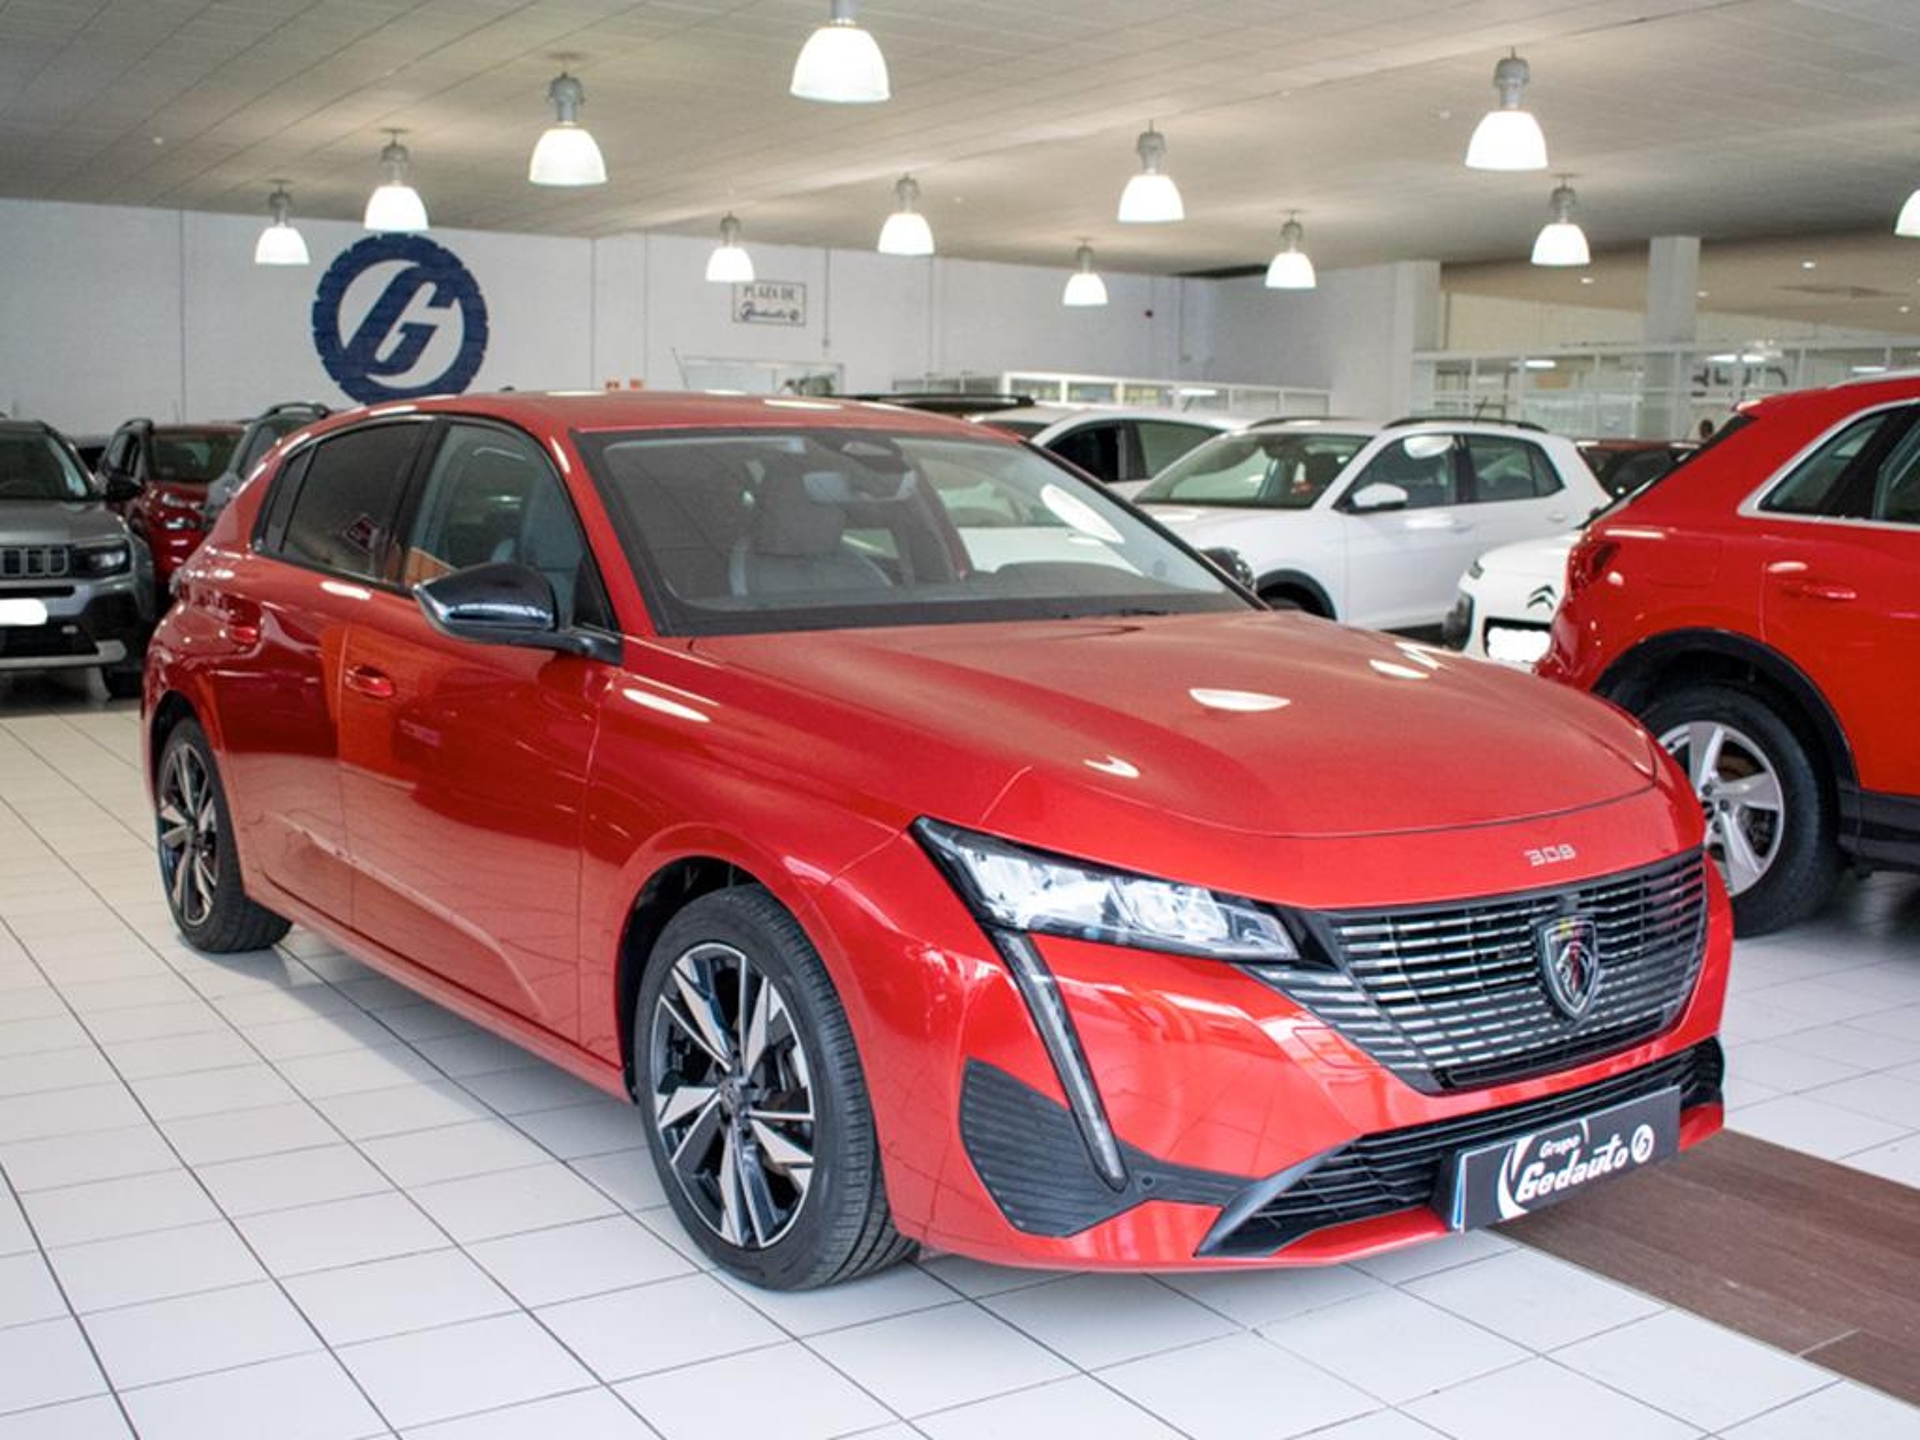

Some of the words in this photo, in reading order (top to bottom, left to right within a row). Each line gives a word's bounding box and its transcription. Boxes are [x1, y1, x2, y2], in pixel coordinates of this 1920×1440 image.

[1523, 843, 1576, 867] 308
[1539, 1135, 1581, 1159] Grupo
[1516, 1134, 1629, 1202] Gedauto
